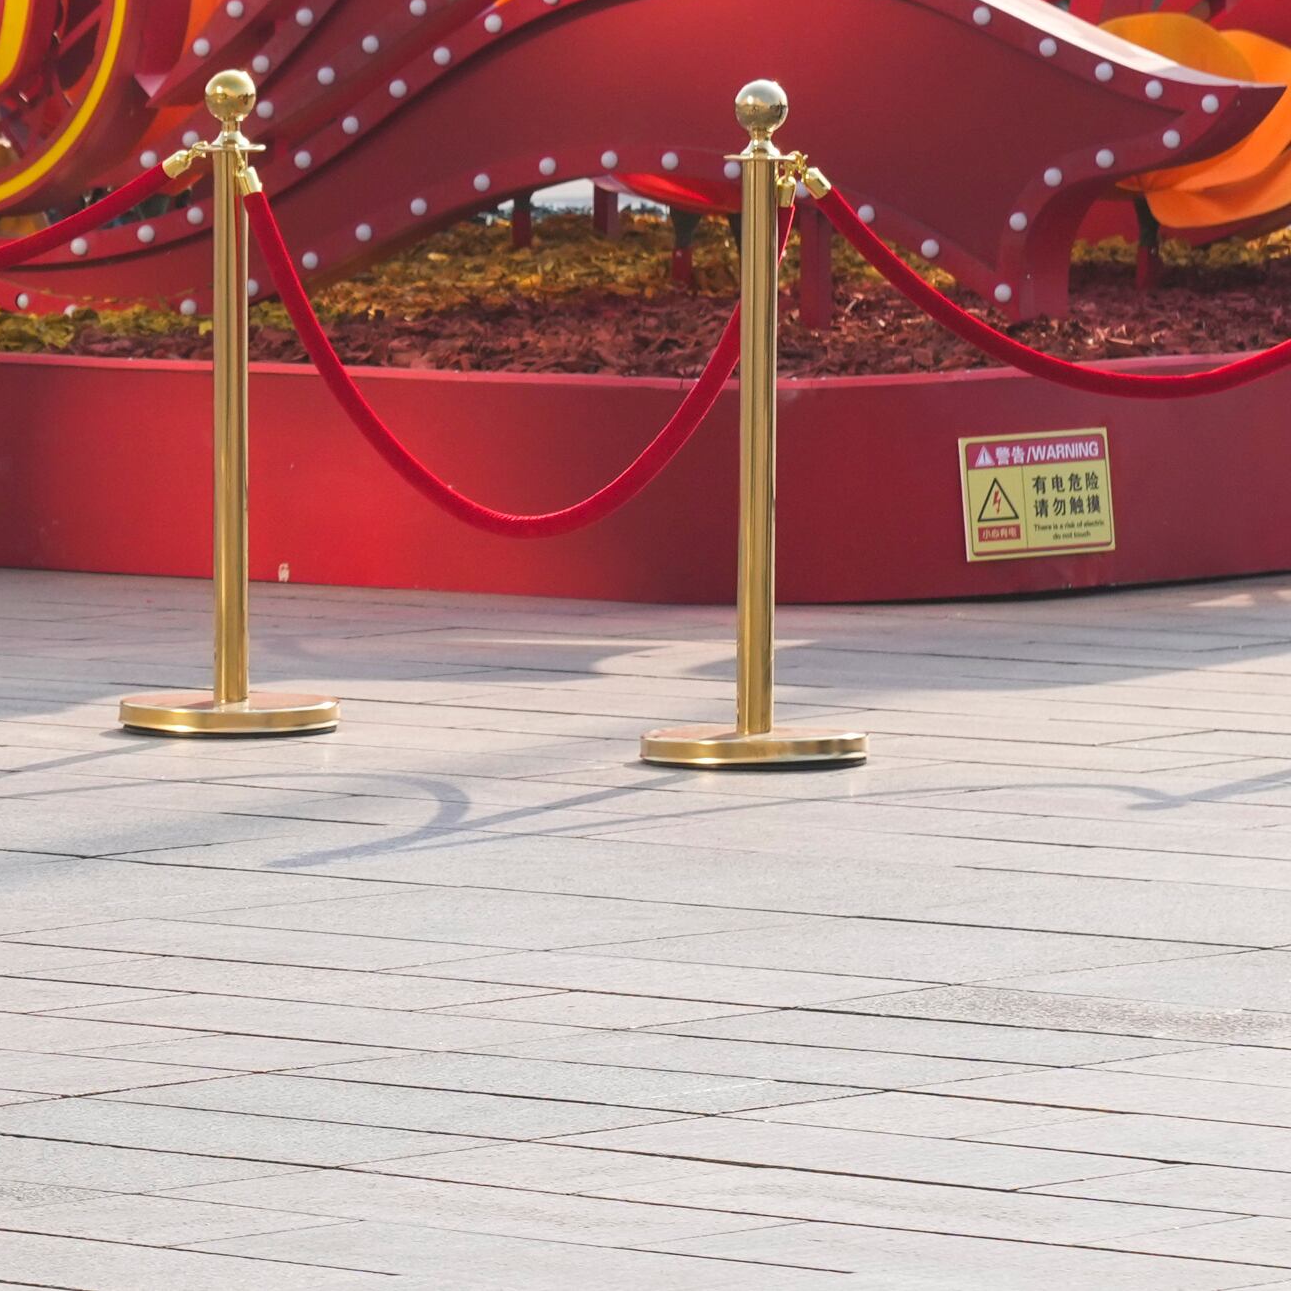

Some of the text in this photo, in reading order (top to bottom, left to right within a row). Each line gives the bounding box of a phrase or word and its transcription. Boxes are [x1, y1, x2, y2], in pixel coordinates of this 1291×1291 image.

[1032, 470, 1100, 495] 有电危险
[1034, 494, 1102, 518] 请勿触摸
